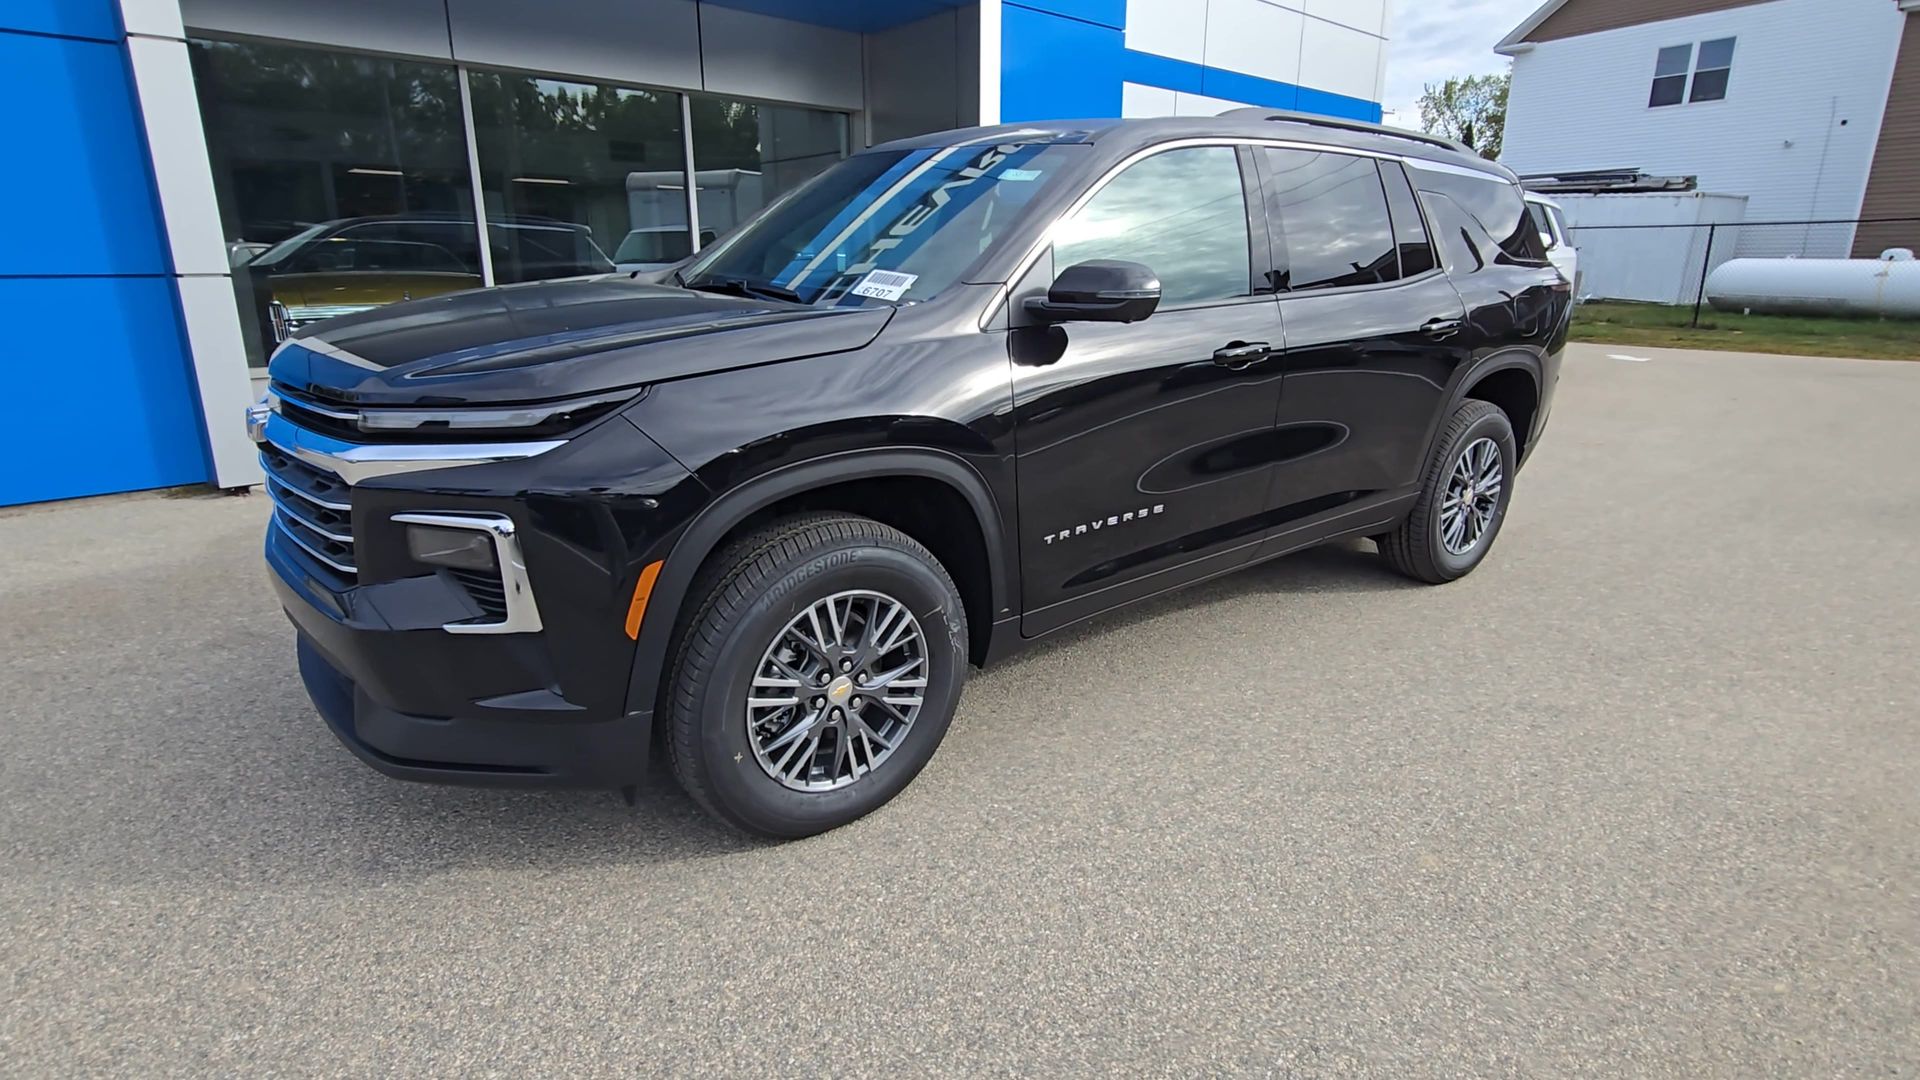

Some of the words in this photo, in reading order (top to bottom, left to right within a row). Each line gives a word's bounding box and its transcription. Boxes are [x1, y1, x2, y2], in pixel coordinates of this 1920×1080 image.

[862, 286, 893, 298] 6707
[1043, 504, 1164, 544] TRAVERSE
[762, 550, 857, 610] BRIDGESTONE
